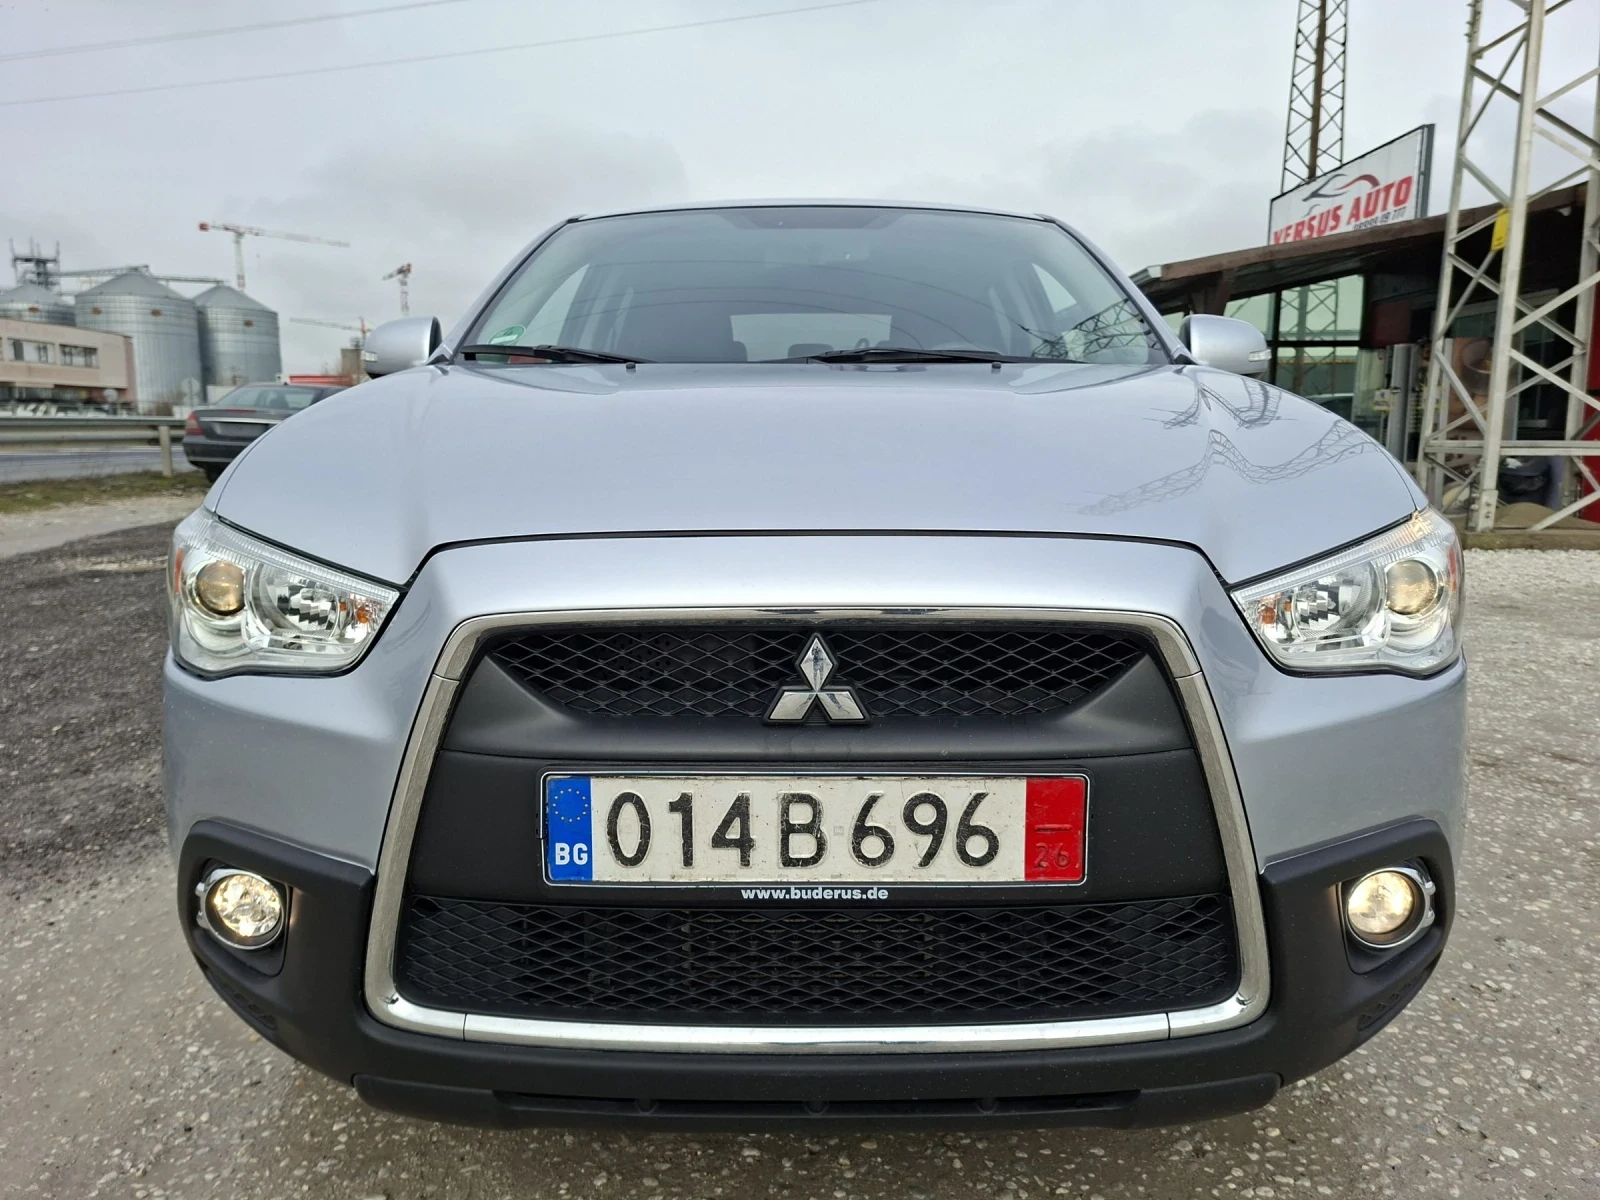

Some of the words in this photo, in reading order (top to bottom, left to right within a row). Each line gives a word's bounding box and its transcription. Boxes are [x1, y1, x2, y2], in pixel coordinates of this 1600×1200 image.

[1273, 205, 1343, 245] VERSUS
[1347, 176, 1413, 225] AUTO
[555, 842, 588, 866] BG
[1034, 842, 1070, 869] 26
[741, 886, 889, 899] www.buderus.de
